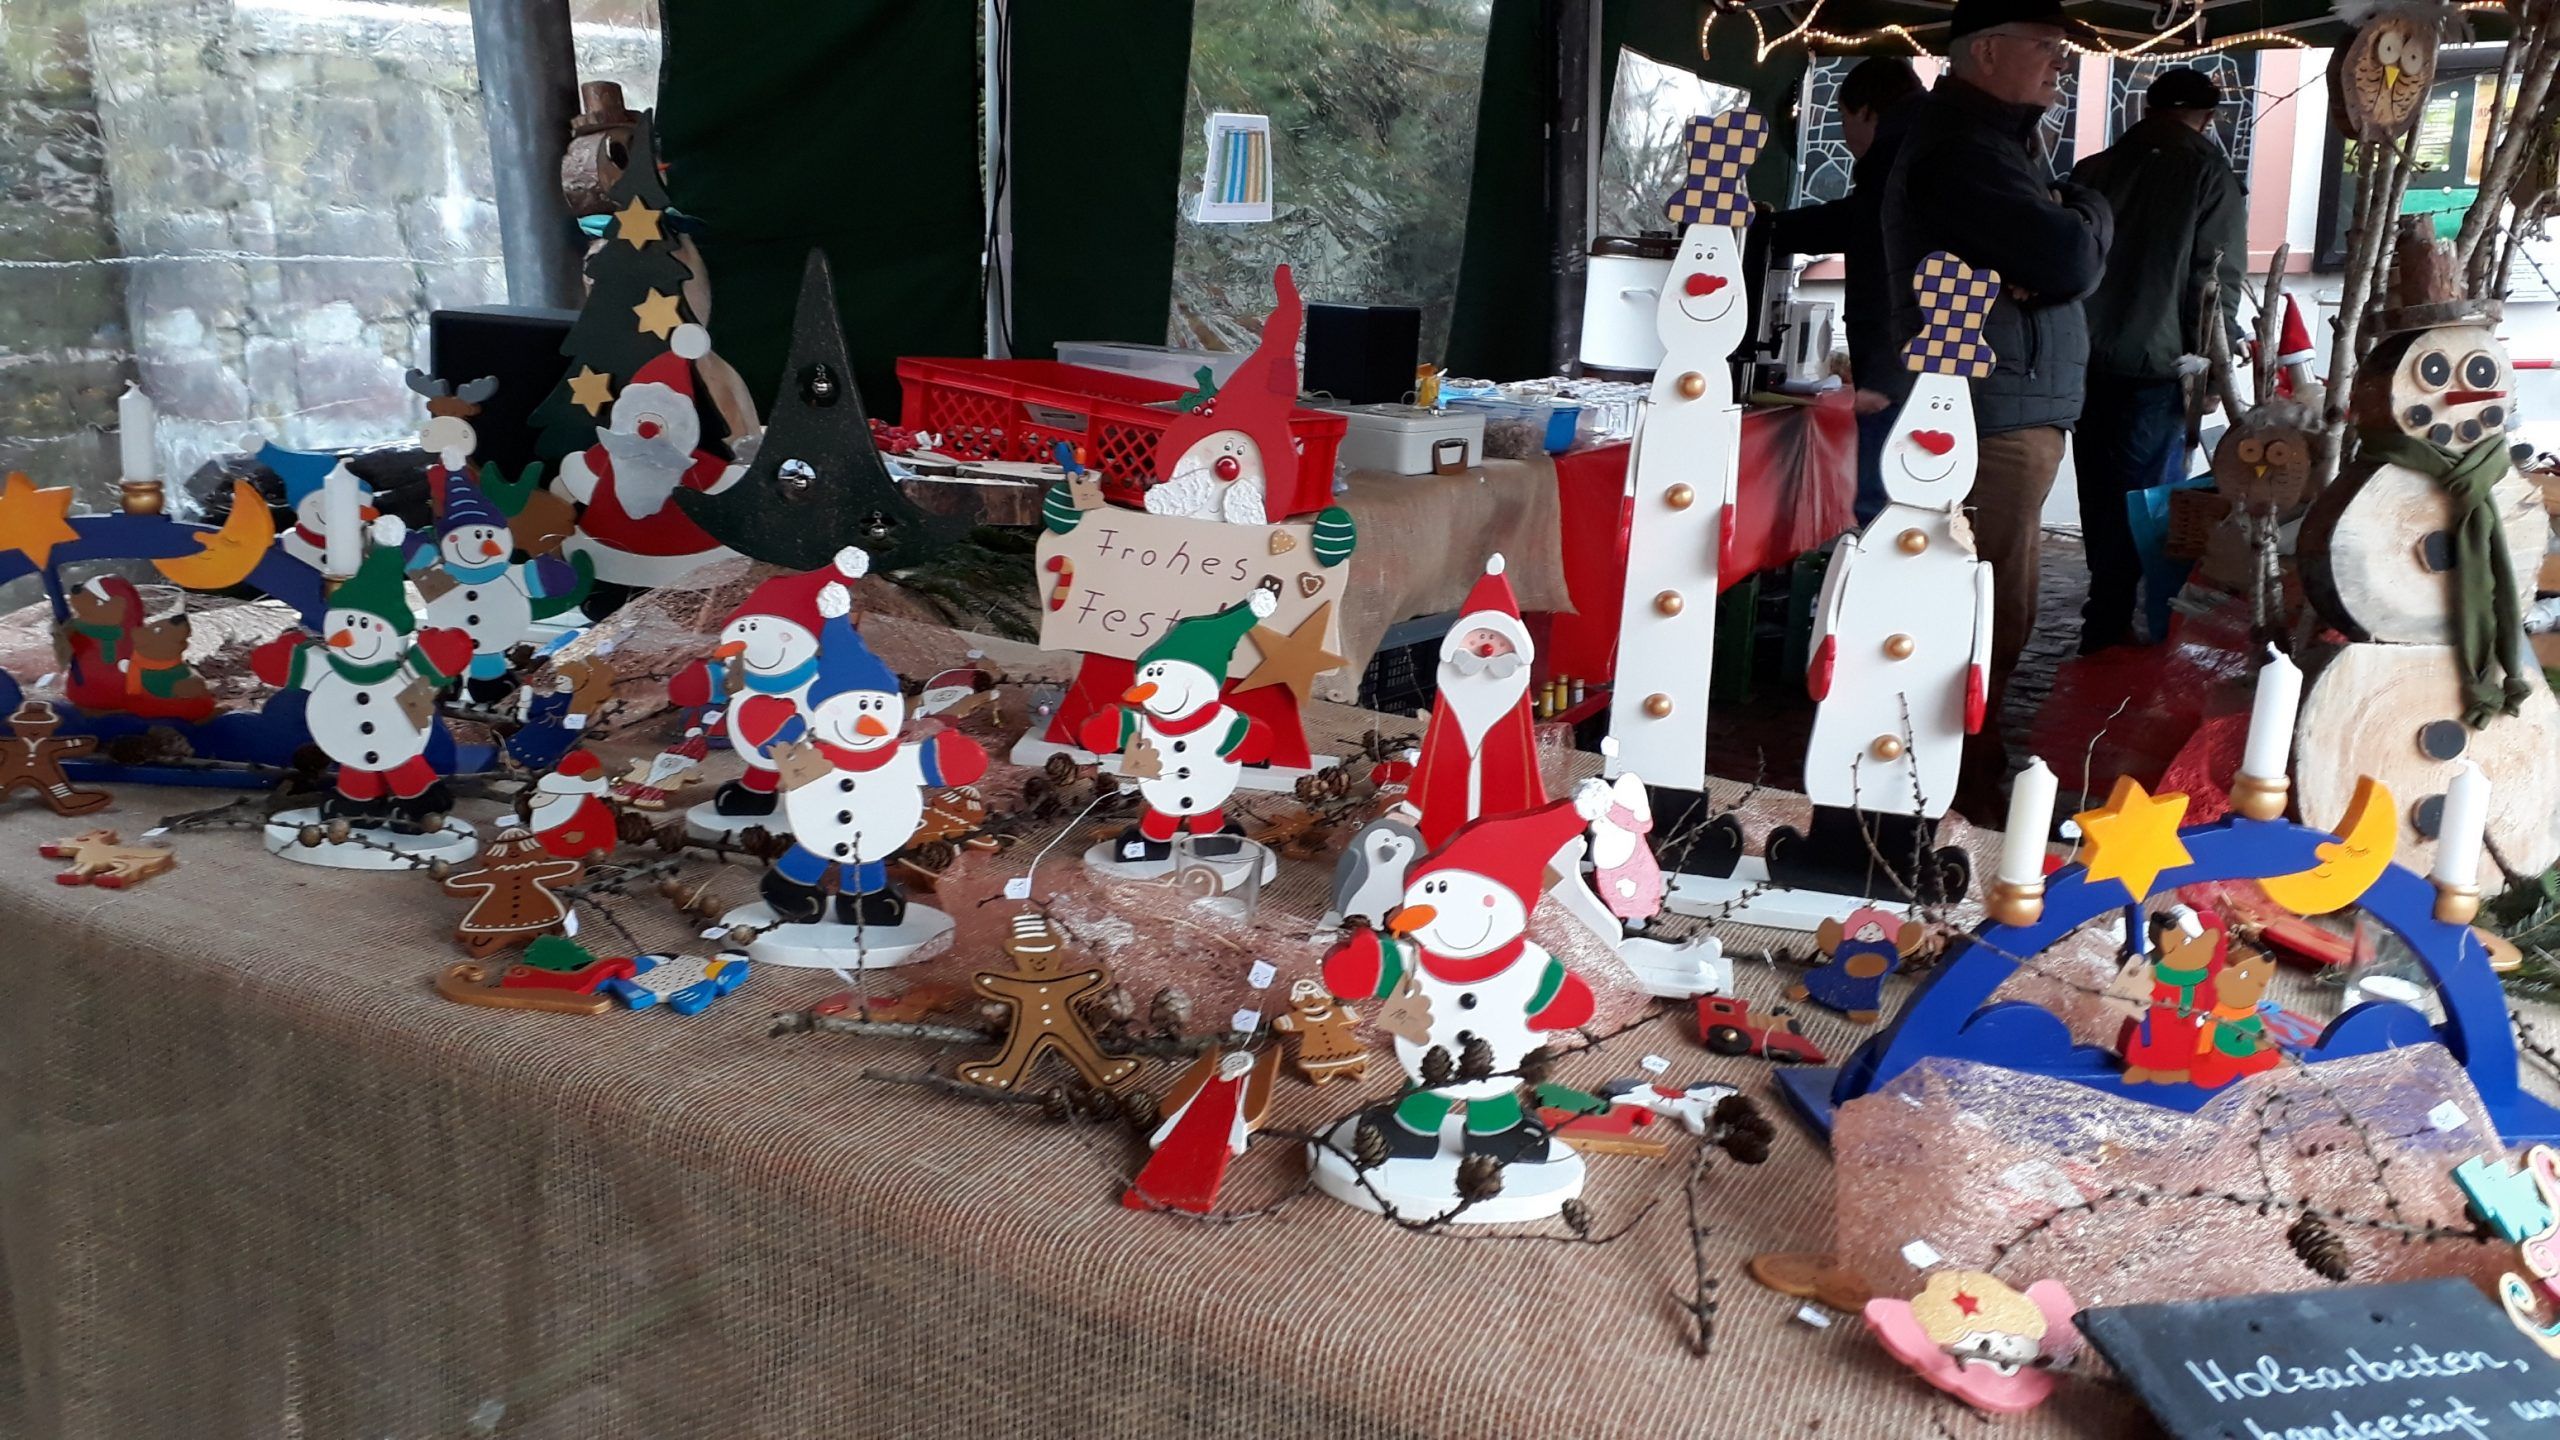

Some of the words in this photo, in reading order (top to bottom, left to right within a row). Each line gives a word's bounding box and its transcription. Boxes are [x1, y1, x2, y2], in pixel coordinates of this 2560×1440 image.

[1097, 529, 1248, 581] Frohes
[1078, 590, 1183, 638] Fest
[2185, 1344, 2530, 1403] Holzarbeiten,
[2508, 1388, 2560, 1421] un
